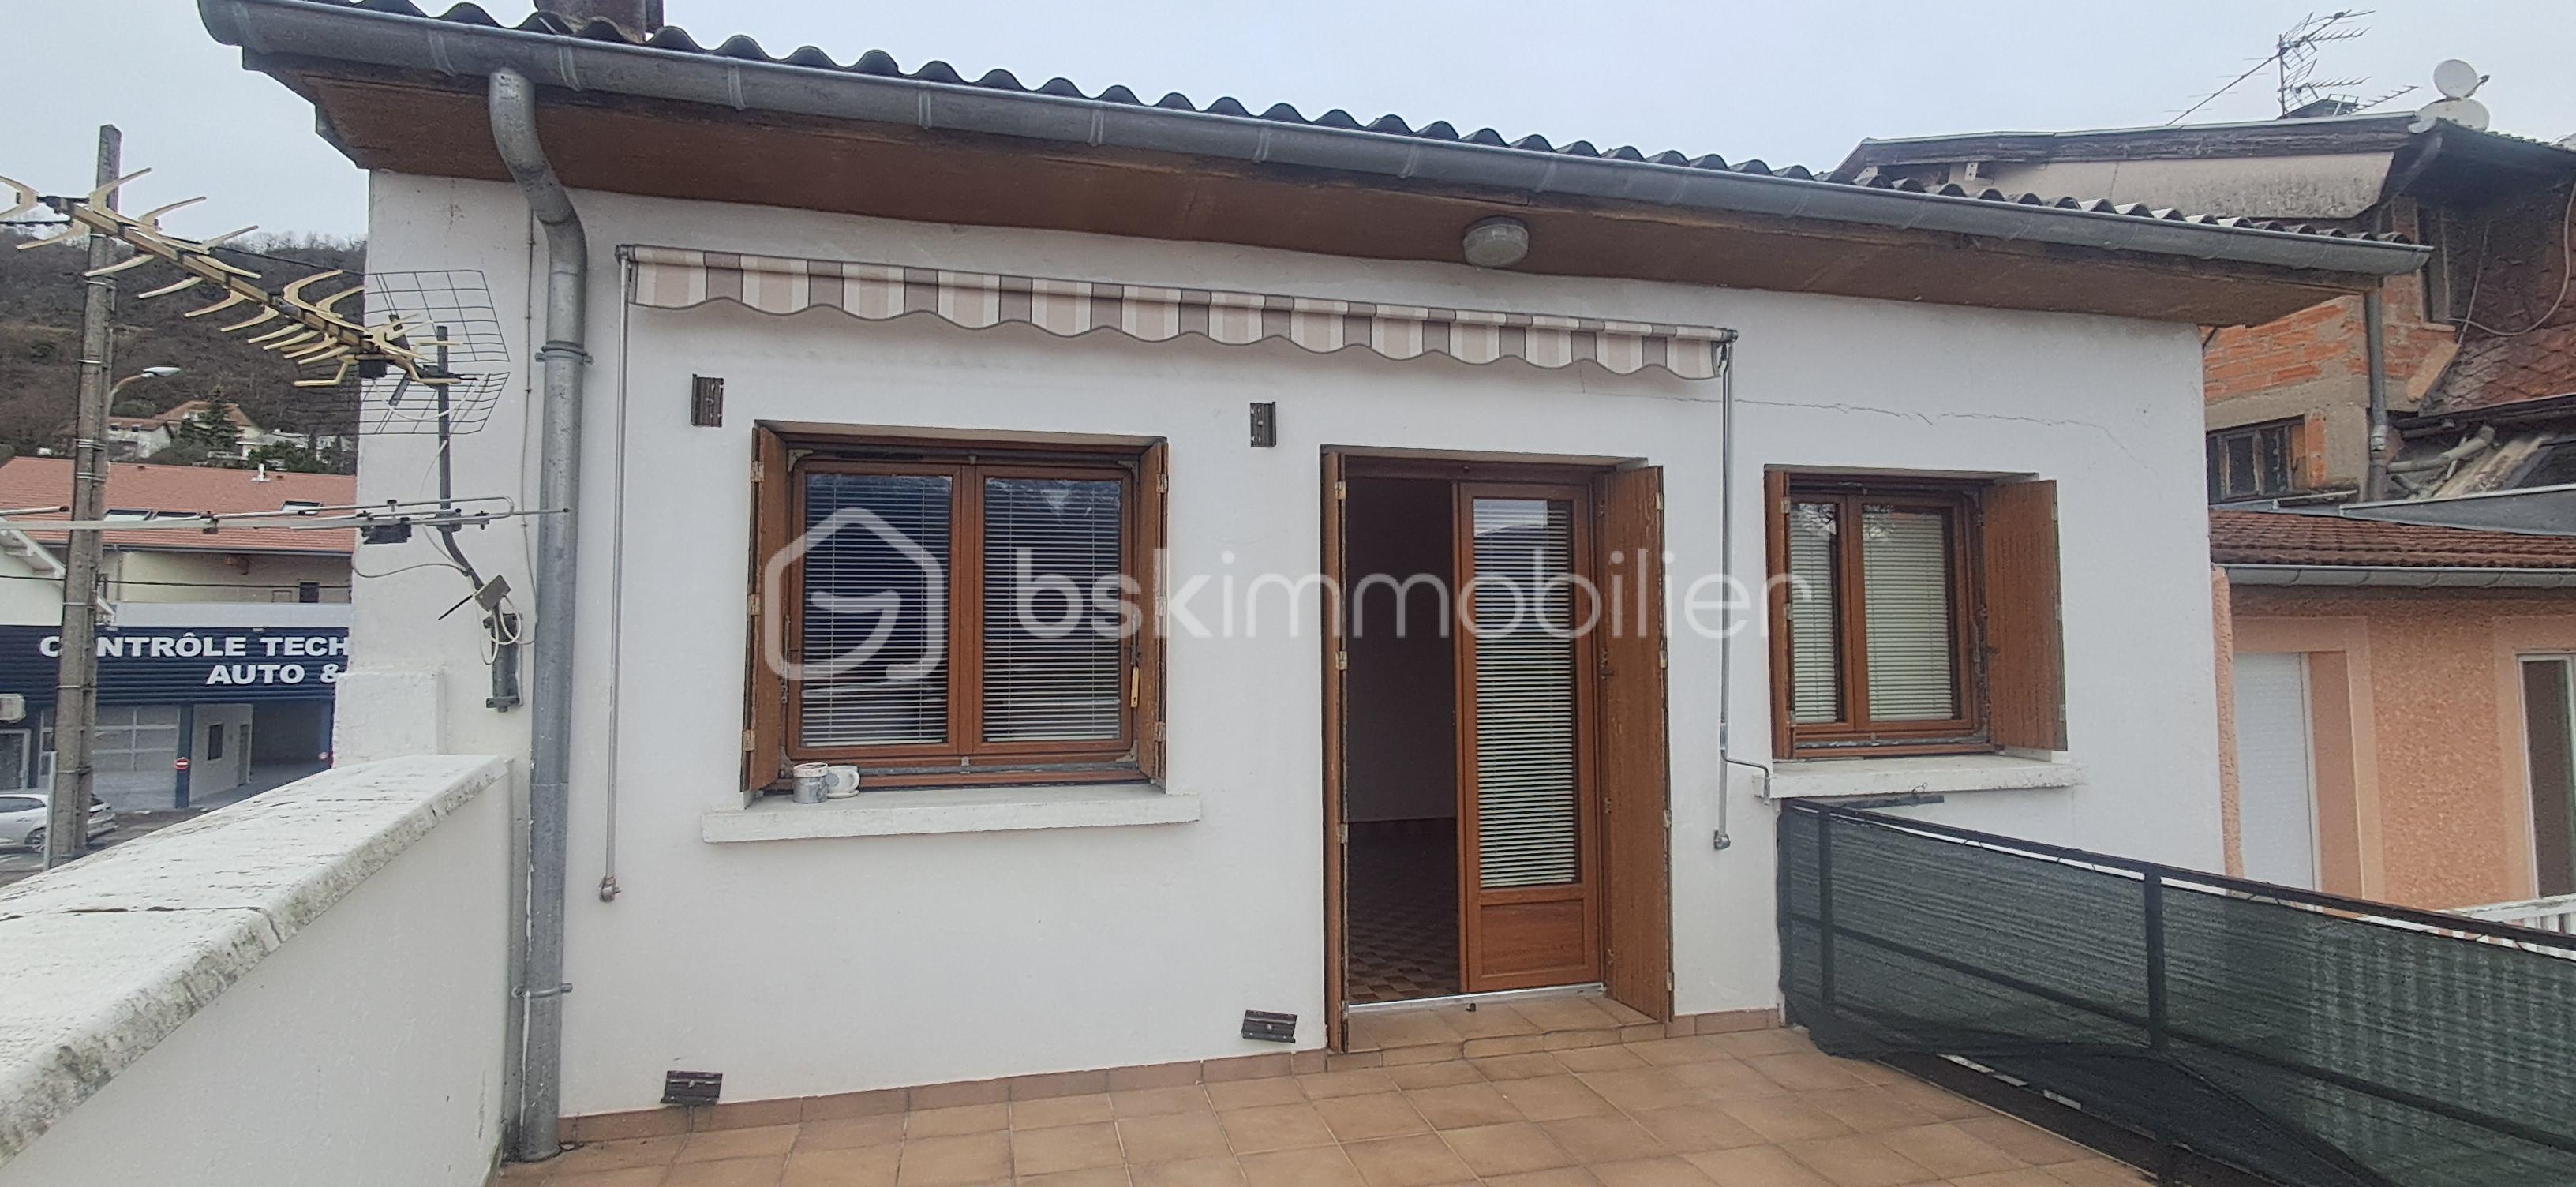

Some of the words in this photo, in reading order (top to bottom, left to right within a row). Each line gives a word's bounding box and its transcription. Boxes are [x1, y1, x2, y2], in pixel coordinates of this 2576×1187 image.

[39, 632, 246, 657] CNTRÔLE
[206, 664, 305, 685] AUTO
[320, 663, 340, 683] &
